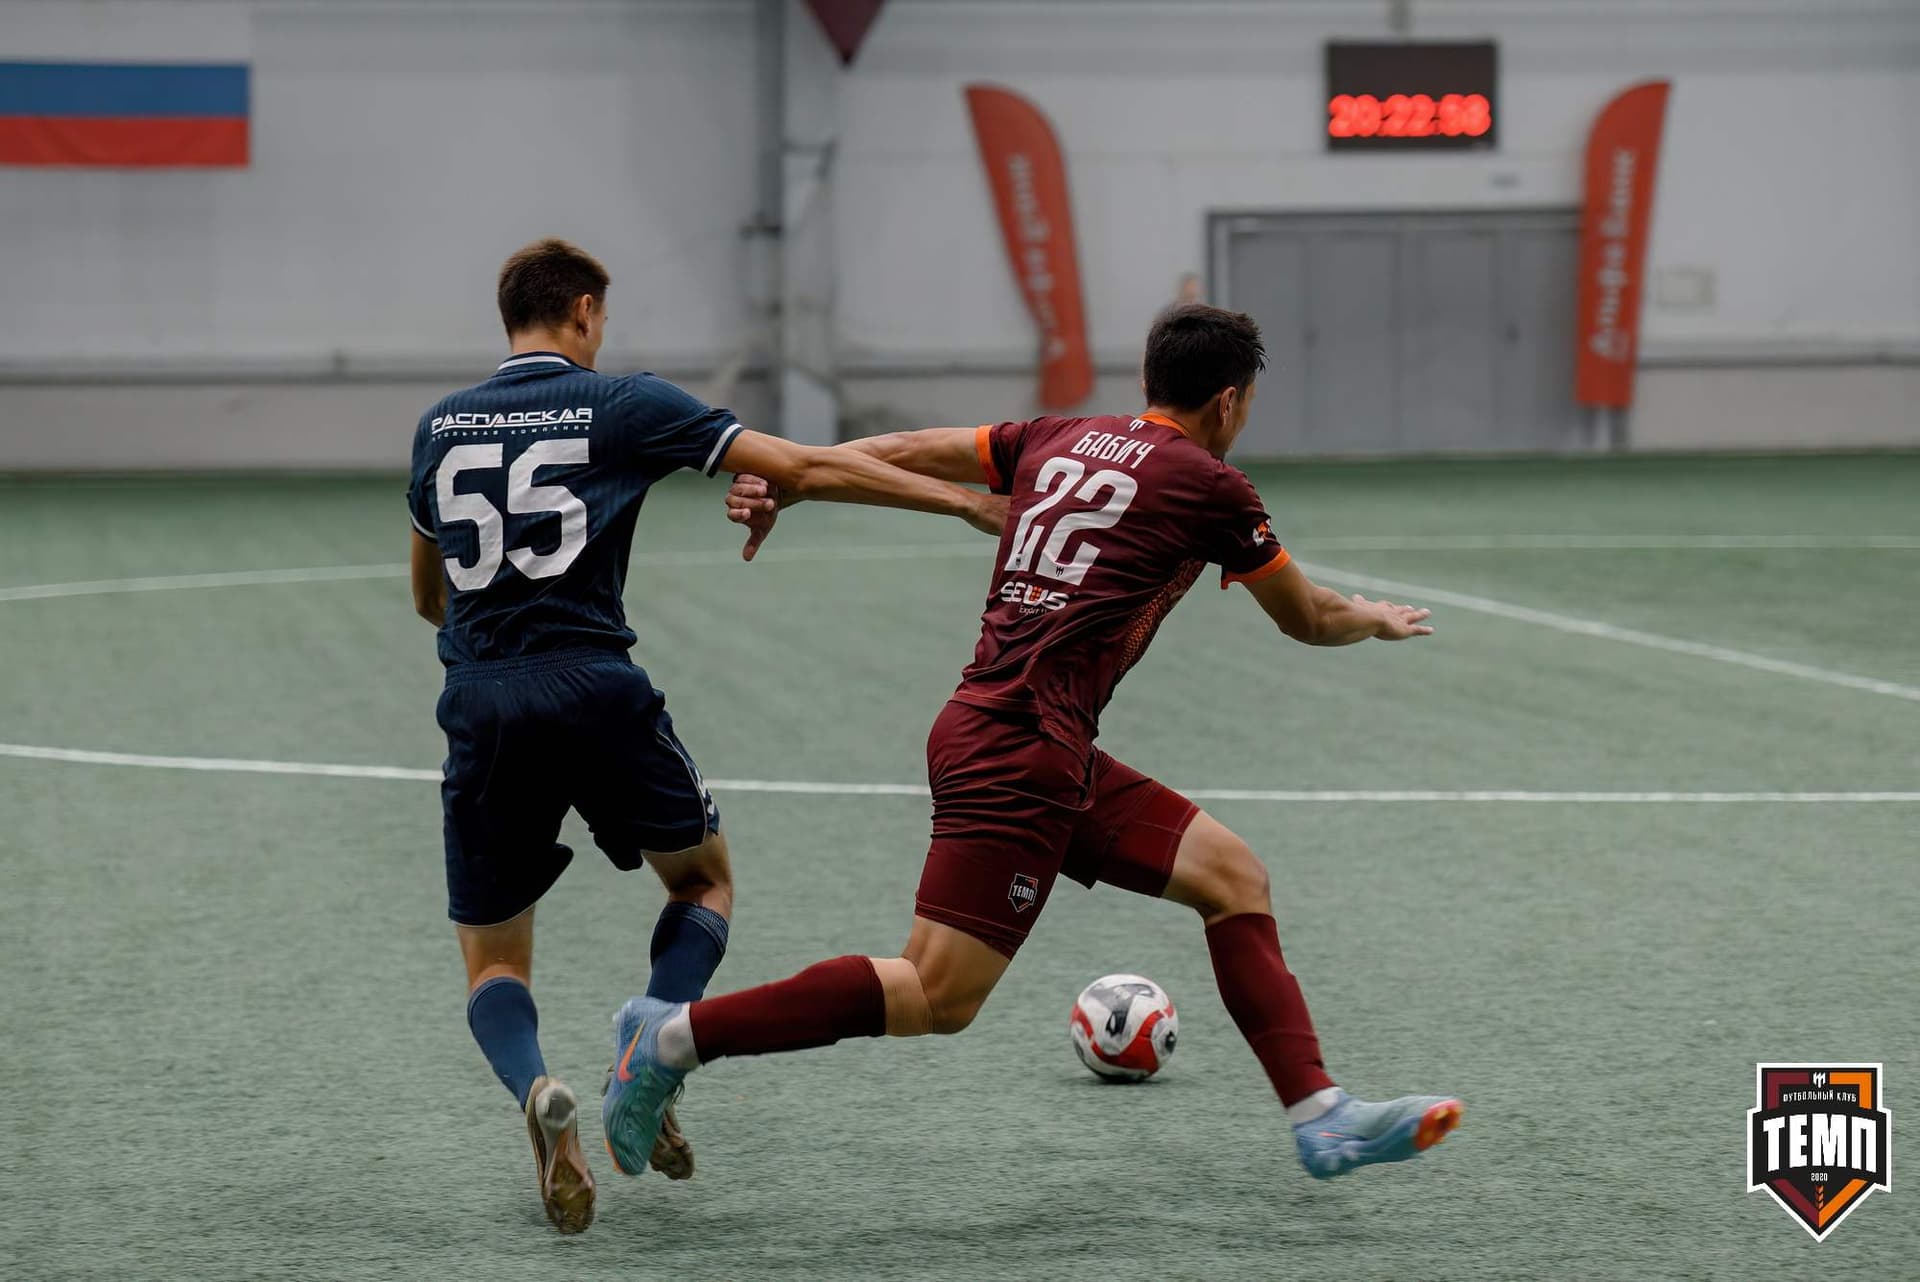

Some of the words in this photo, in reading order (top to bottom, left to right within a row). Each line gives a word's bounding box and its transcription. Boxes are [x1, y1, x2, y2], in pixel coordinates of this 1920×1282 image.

[431, 407, 593, 435] РАСПАДСКАЯ
[1070, 430, 1156, 469] БАБИЧ
[436, 438, 589, 591] 55
[1004, 456, 1138, 586] 22
[1012, 884, 1035, 901] ТЕМП
